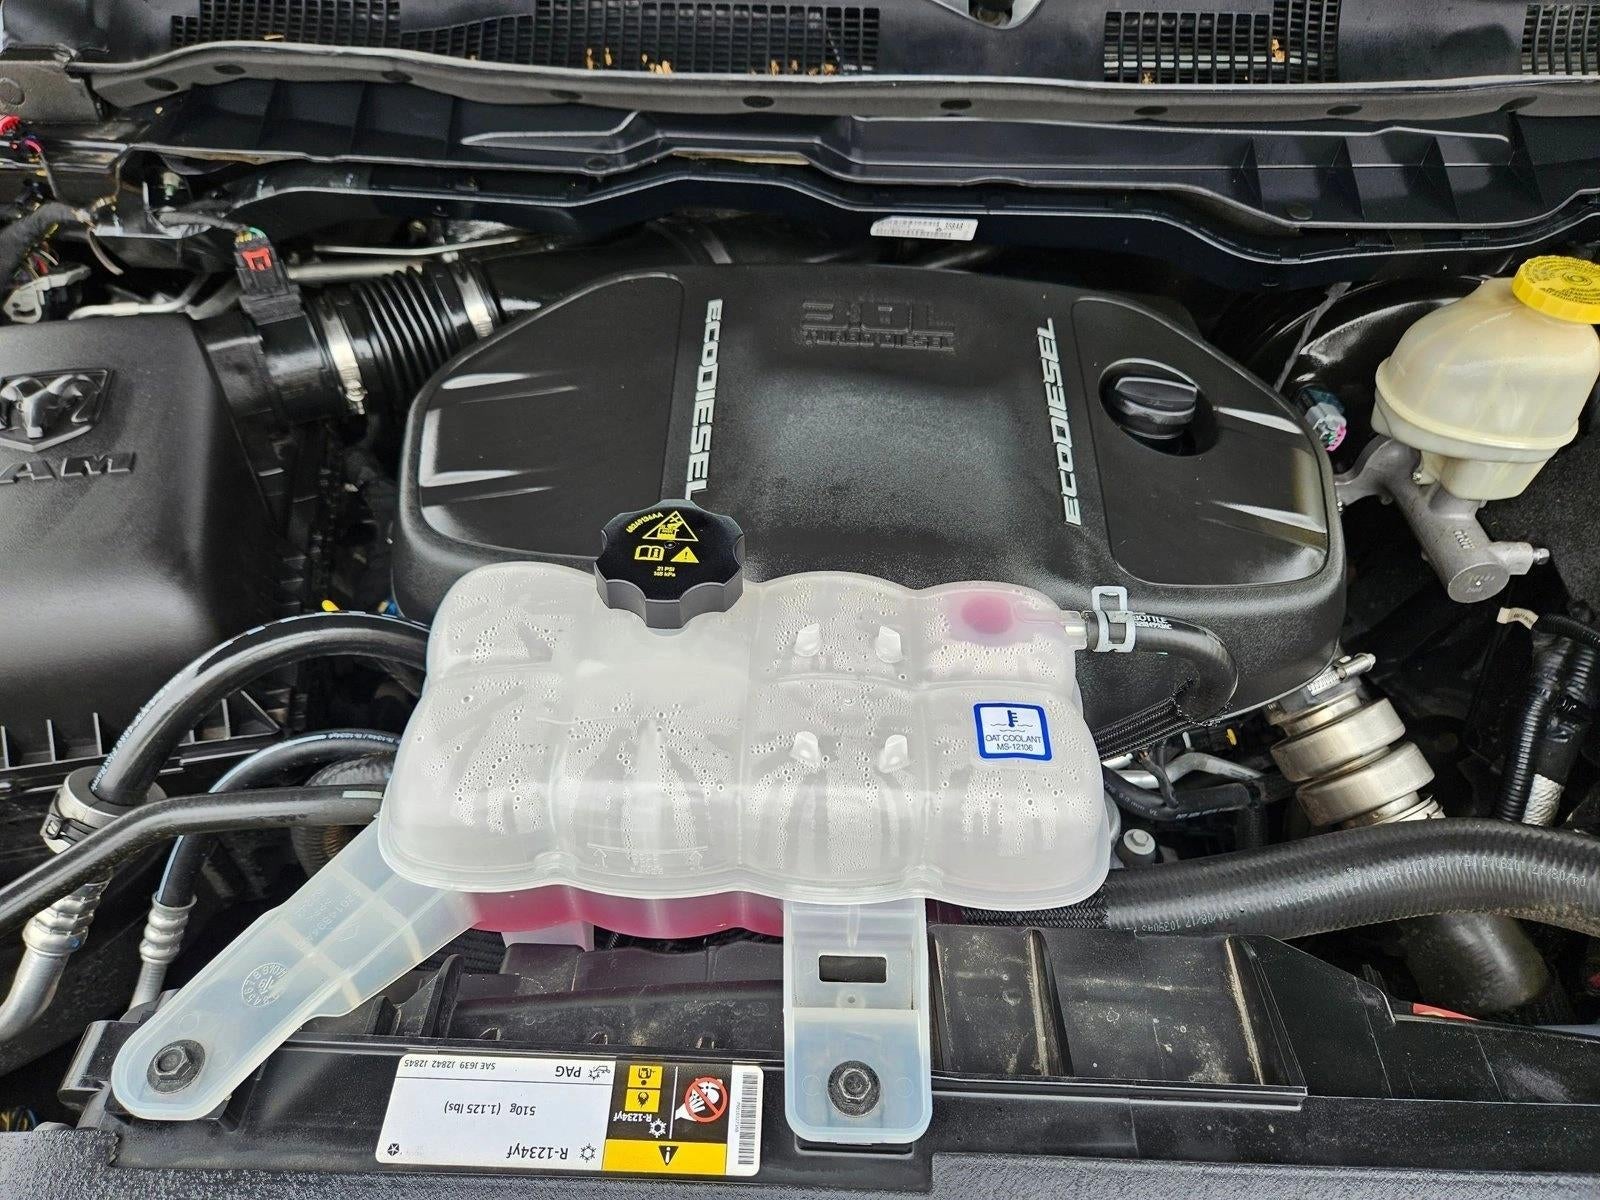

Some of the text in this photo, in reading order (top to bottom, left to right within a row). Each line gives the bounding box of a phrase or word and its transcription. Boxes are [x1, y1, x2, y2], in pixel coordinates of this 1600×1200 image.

[685, 299, 722, 500] ECODIESEL
[1037, 318, 1081, 526] ECODIESEL
[0, 453, 137, 484] AM
[985, 734, 1042, 744] OAT COOLANT
[996, 743, 1034, 752] MS-12106
[404, 1059, 497, 1071] SAE J639 J2842 J2845
[555, 1066, 582, 1078] PAG
[444, 1101, 537, 1117] 510g (1.125 lbs)
[613, 1111, 653, 1123] R-1234yf
[505, 1143, 569, 1161] R-1234yf
